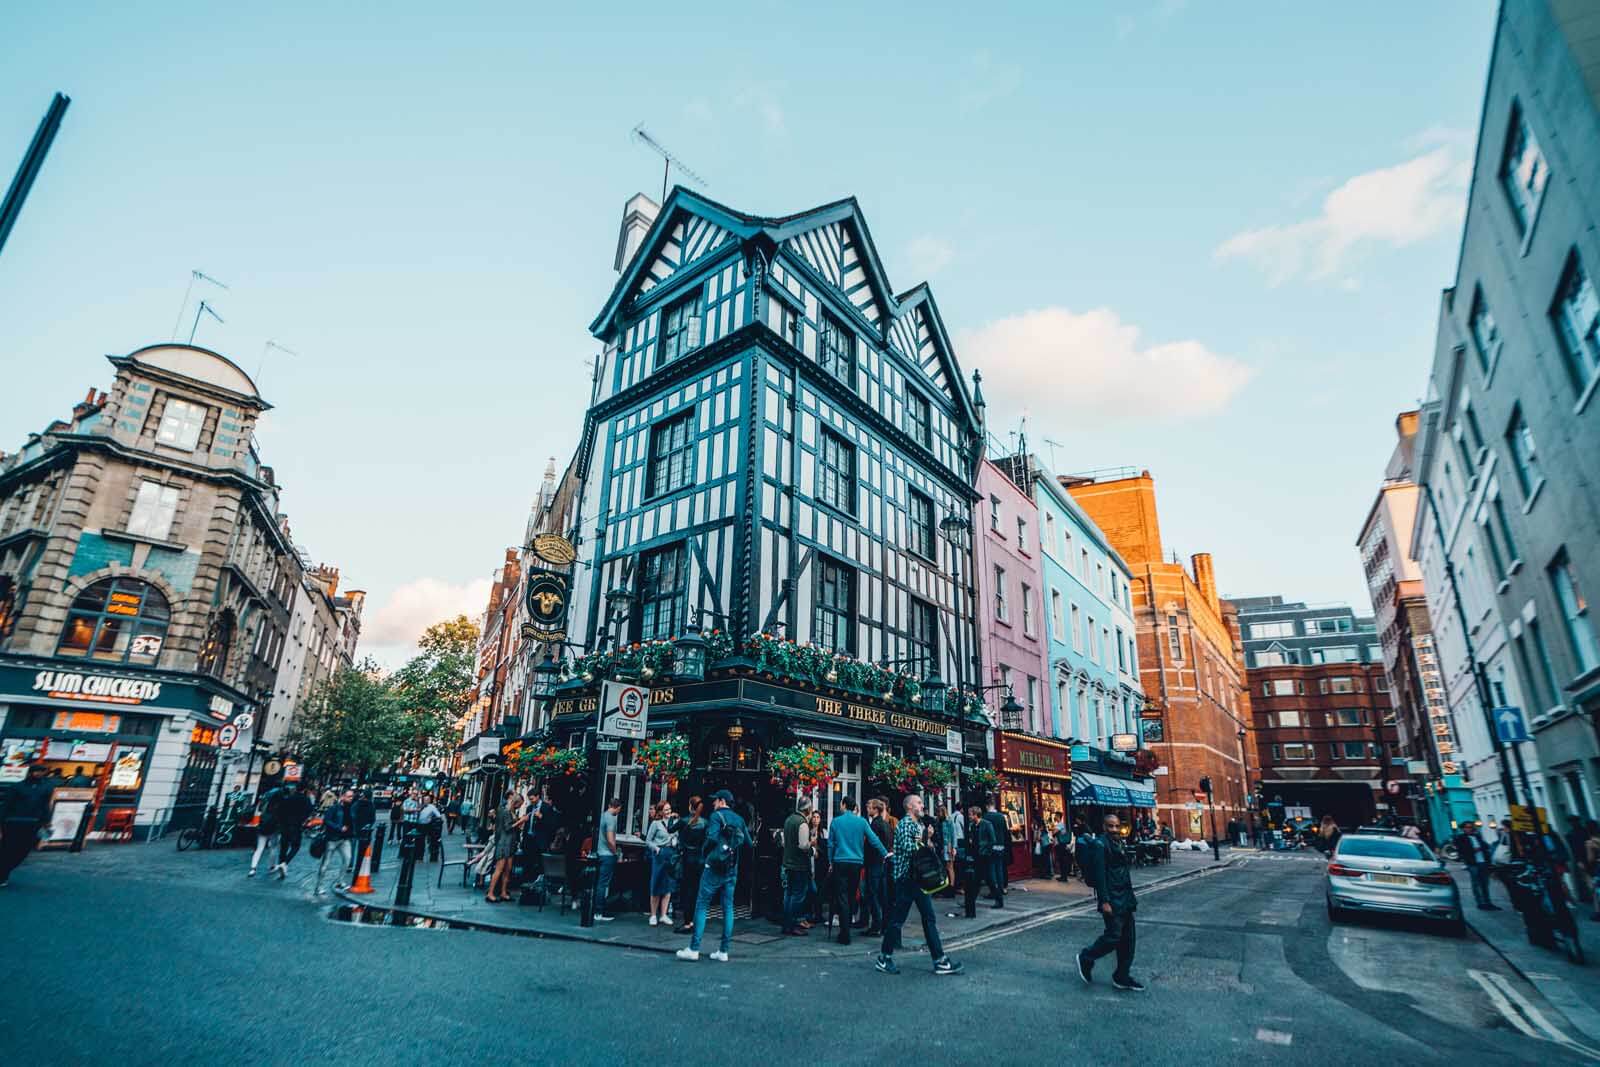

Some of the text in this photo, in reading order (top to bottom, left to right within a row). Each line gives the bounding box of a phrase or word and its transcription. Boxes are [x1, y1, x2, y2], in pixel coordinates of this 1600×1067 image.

[32, 671, 83, 693] SLIM
[81, 676, 162, 700] CHICKENS
[816, 697, 843, 716] THE
[848, 704, 886, 724] THREE
